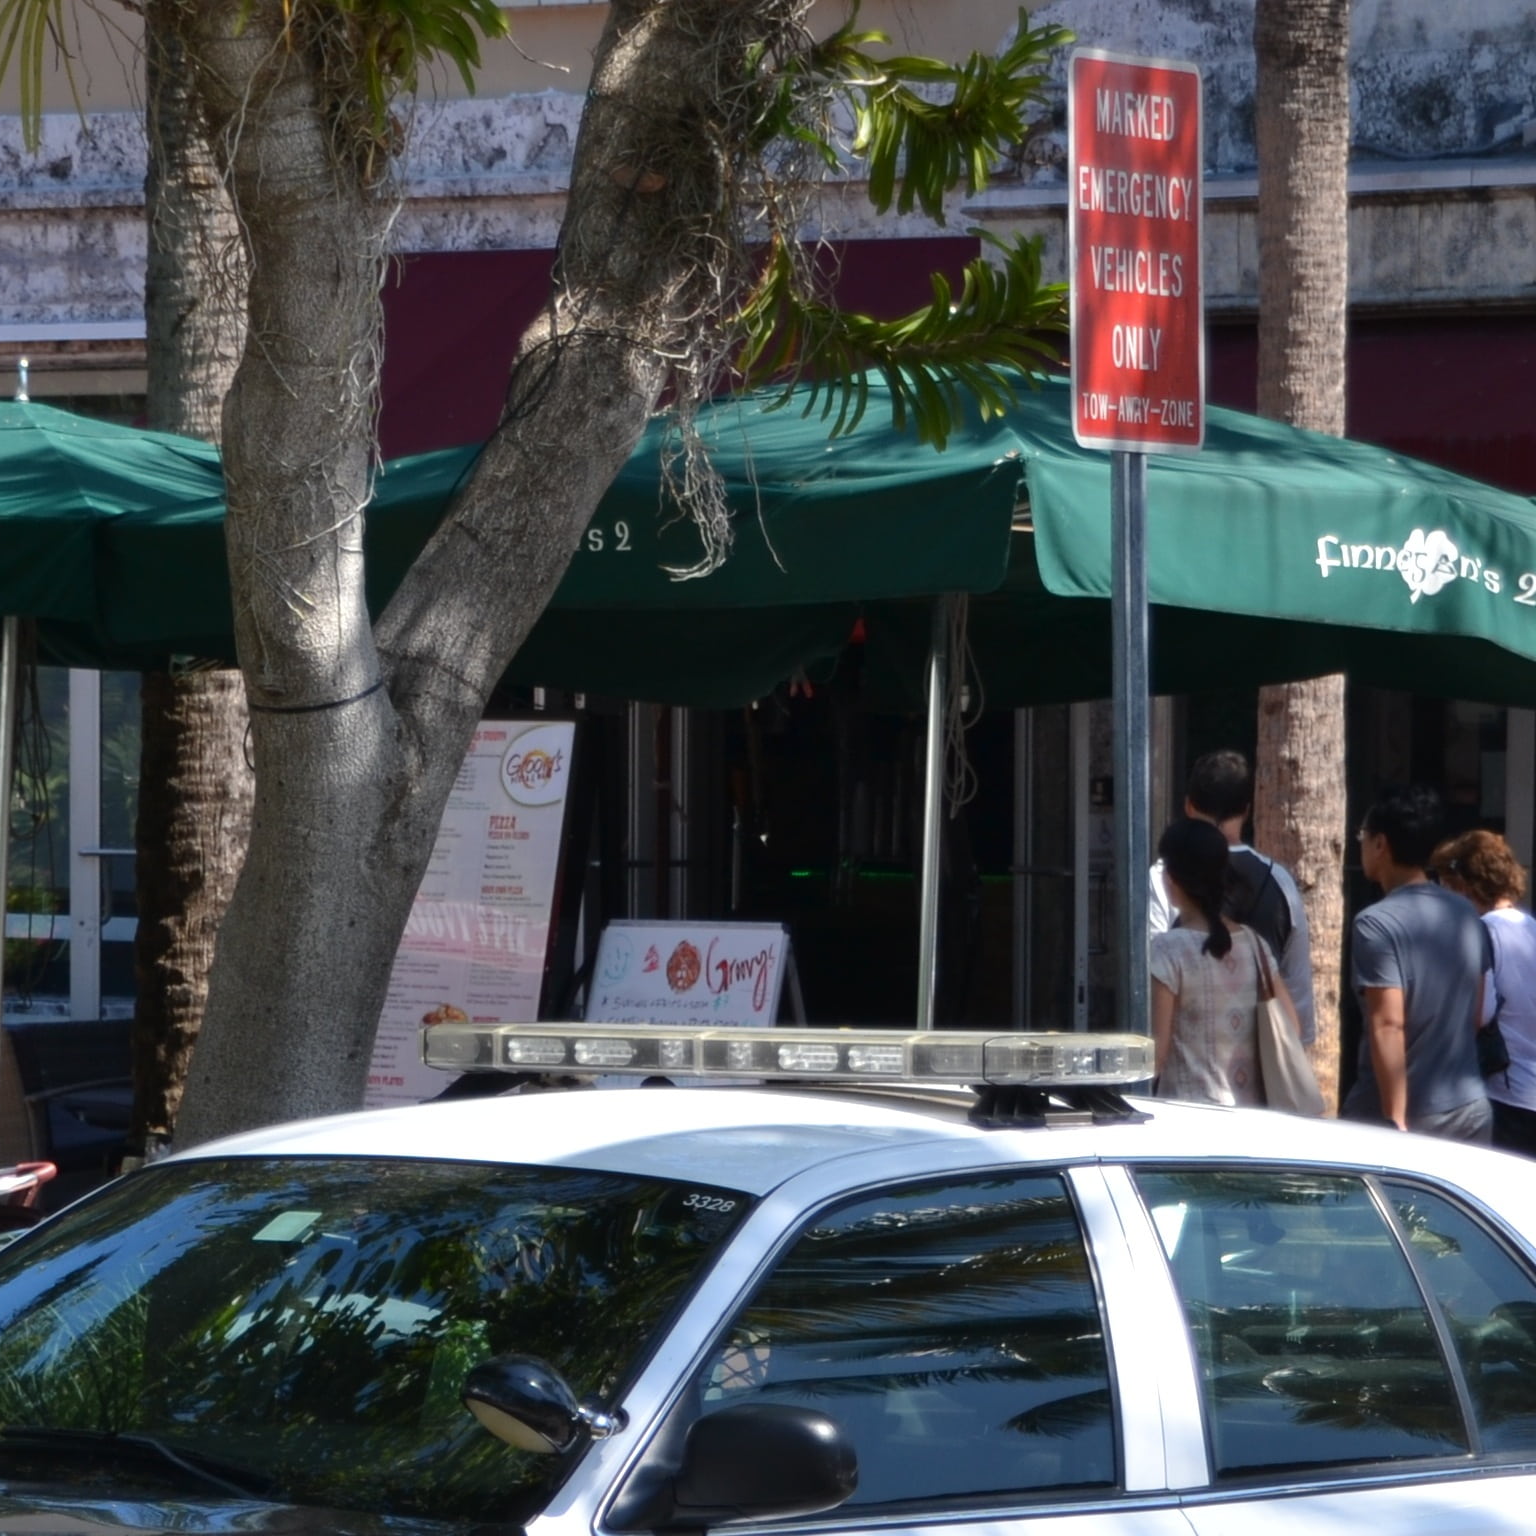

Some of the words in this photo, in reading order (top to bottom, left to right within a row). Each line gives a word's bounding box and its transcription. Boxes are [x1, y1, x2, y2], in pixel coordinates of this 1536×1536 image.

[1095, 86, 1175, 142] MARKED
[1079, 165, 1193, 222] EMERGENCY
[1090, 245, 1183, 299] VEHICLES
[1111, 323, 1162, 373] ONLY
[1081, 391, 1195, 429] TOW-AWAY-ZONE
[614, 520, 632, 552] 2
[682, 1192, 736, 1212] 3328
